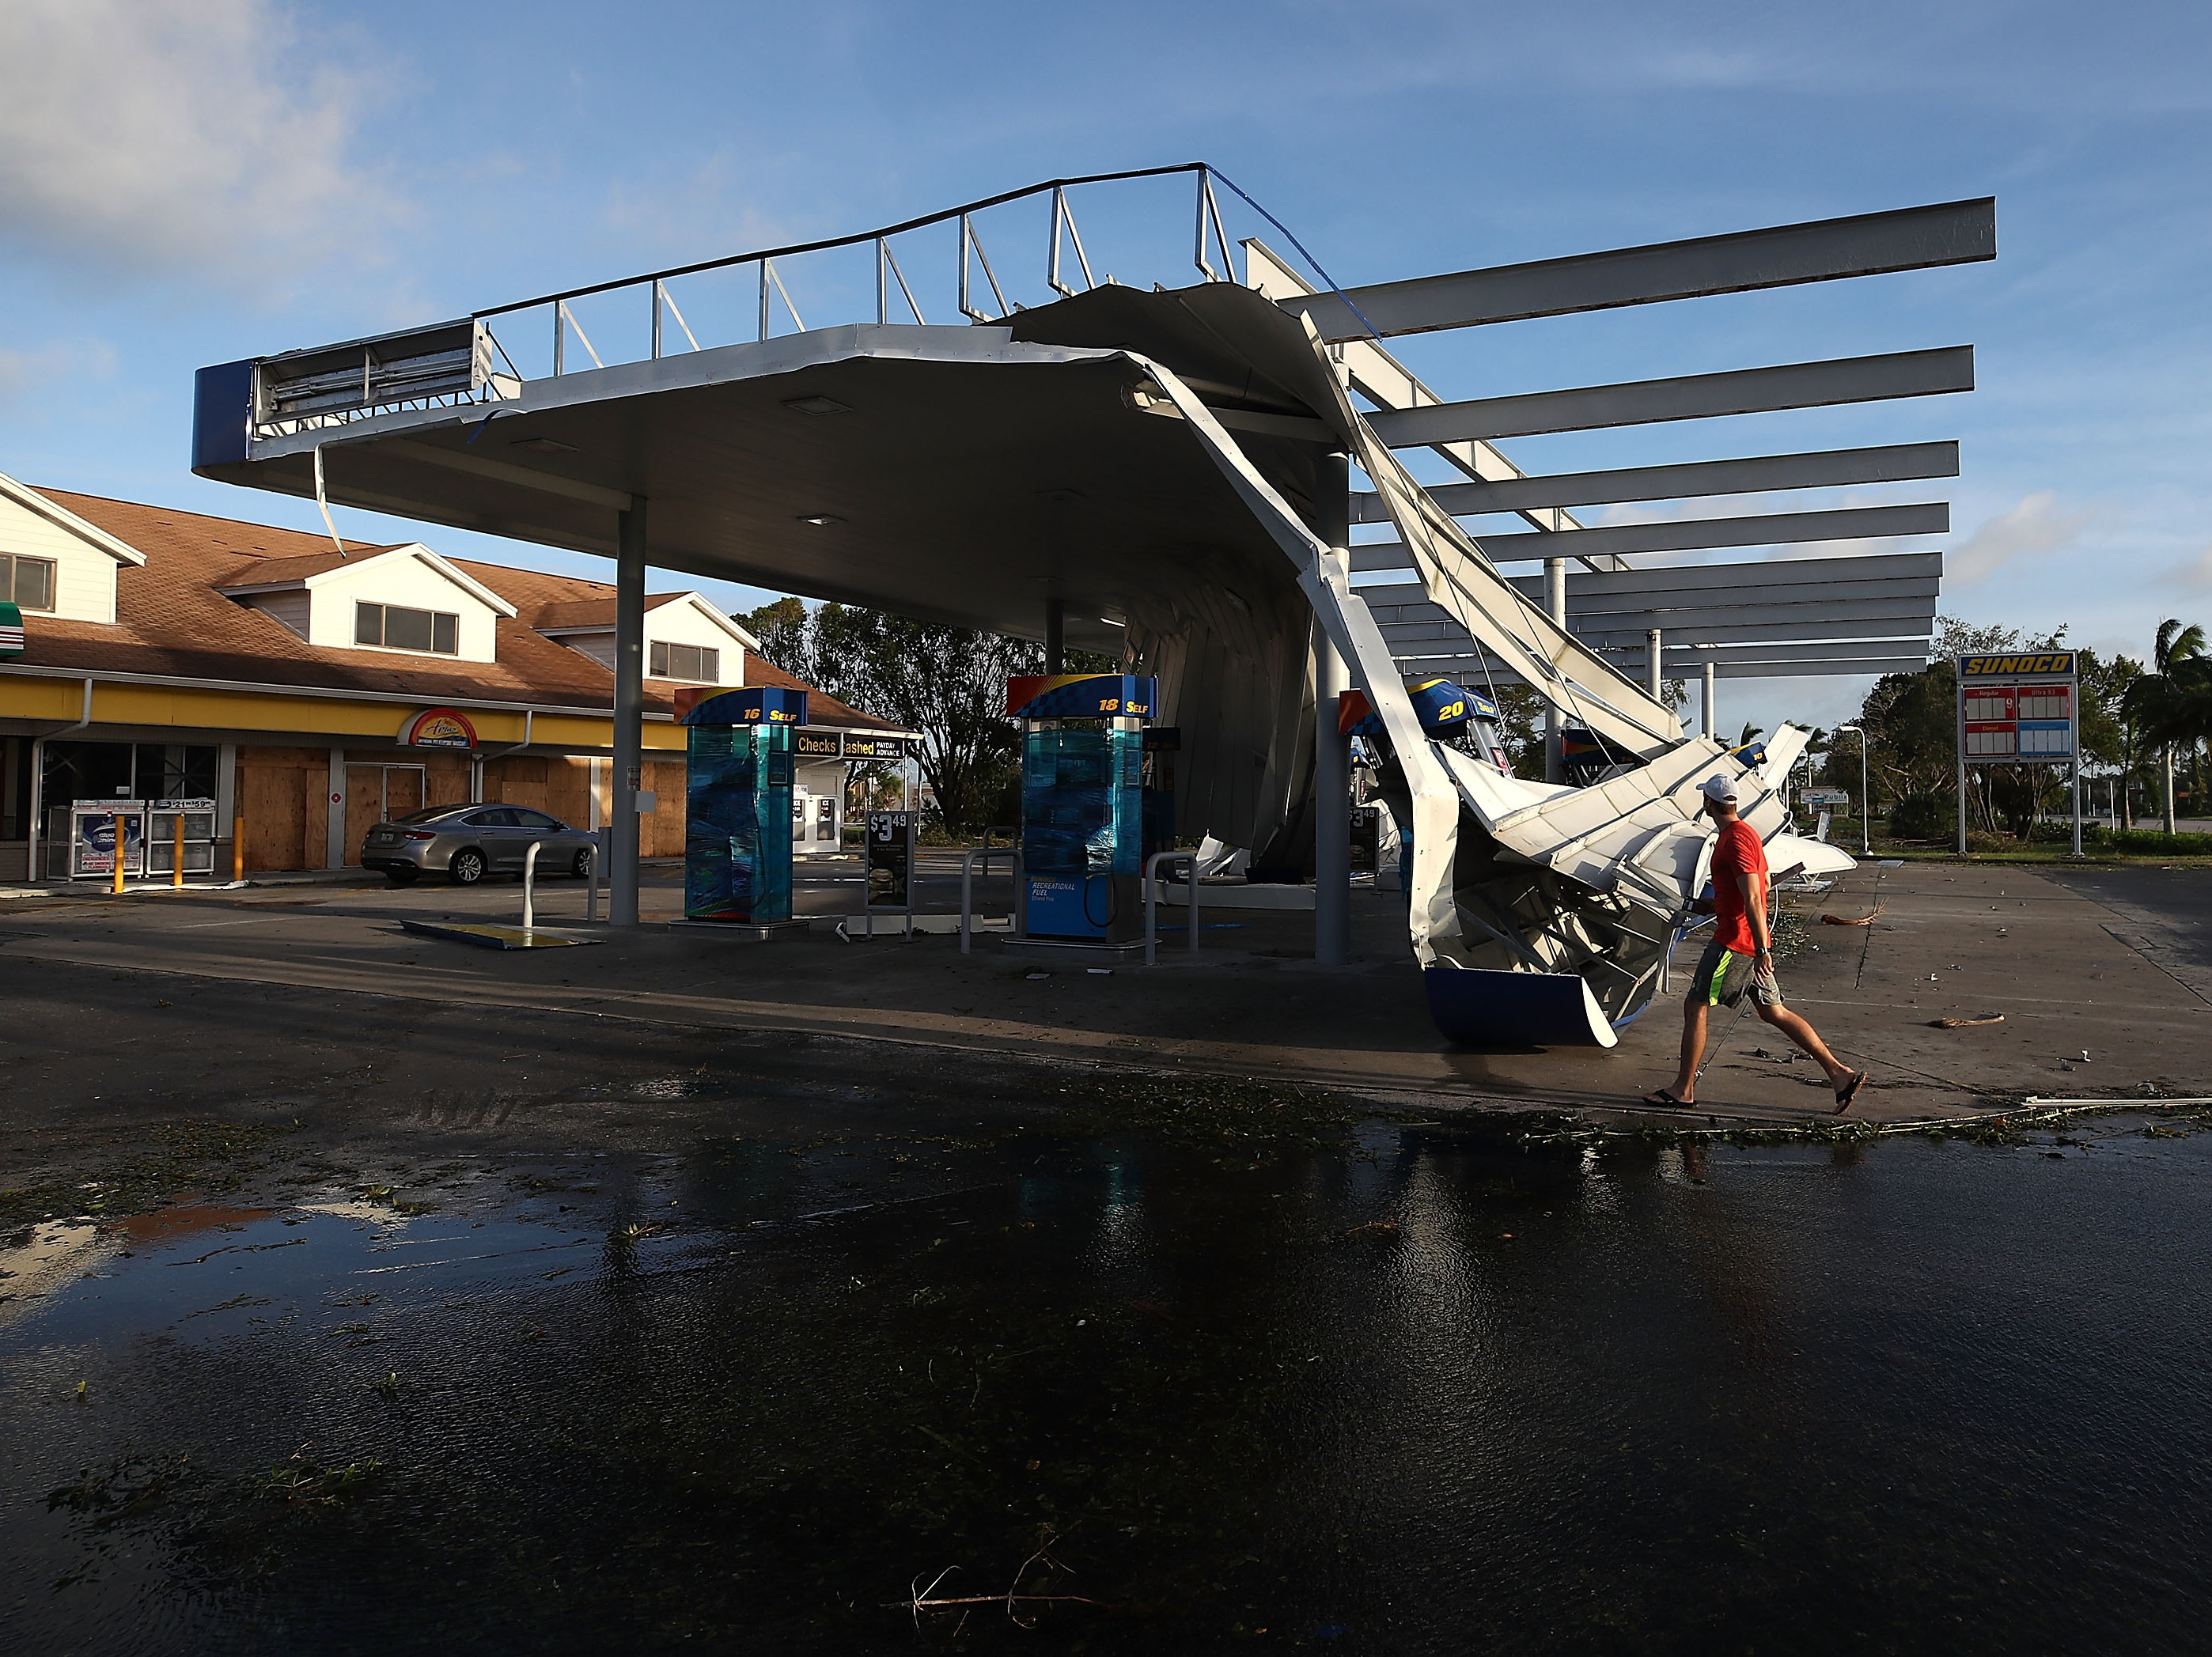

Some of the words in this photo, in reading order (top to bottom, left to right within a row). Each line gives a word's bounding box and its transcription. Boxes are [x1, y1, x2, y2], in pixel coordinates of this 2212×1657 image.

[1965, 656, 2070, 674] SUNOCO
[1099, 698, 1119, 711] 18
[2006, 698, 2013, 709] 9
[744, 709, 760, 720] 16
[1439, 701, 1464, 721] 20
[798, 737, 836, 752] Checks
[843, 740, 874, 755] ashed
[1032, 882, 1075, 891] RECREATIONAL
